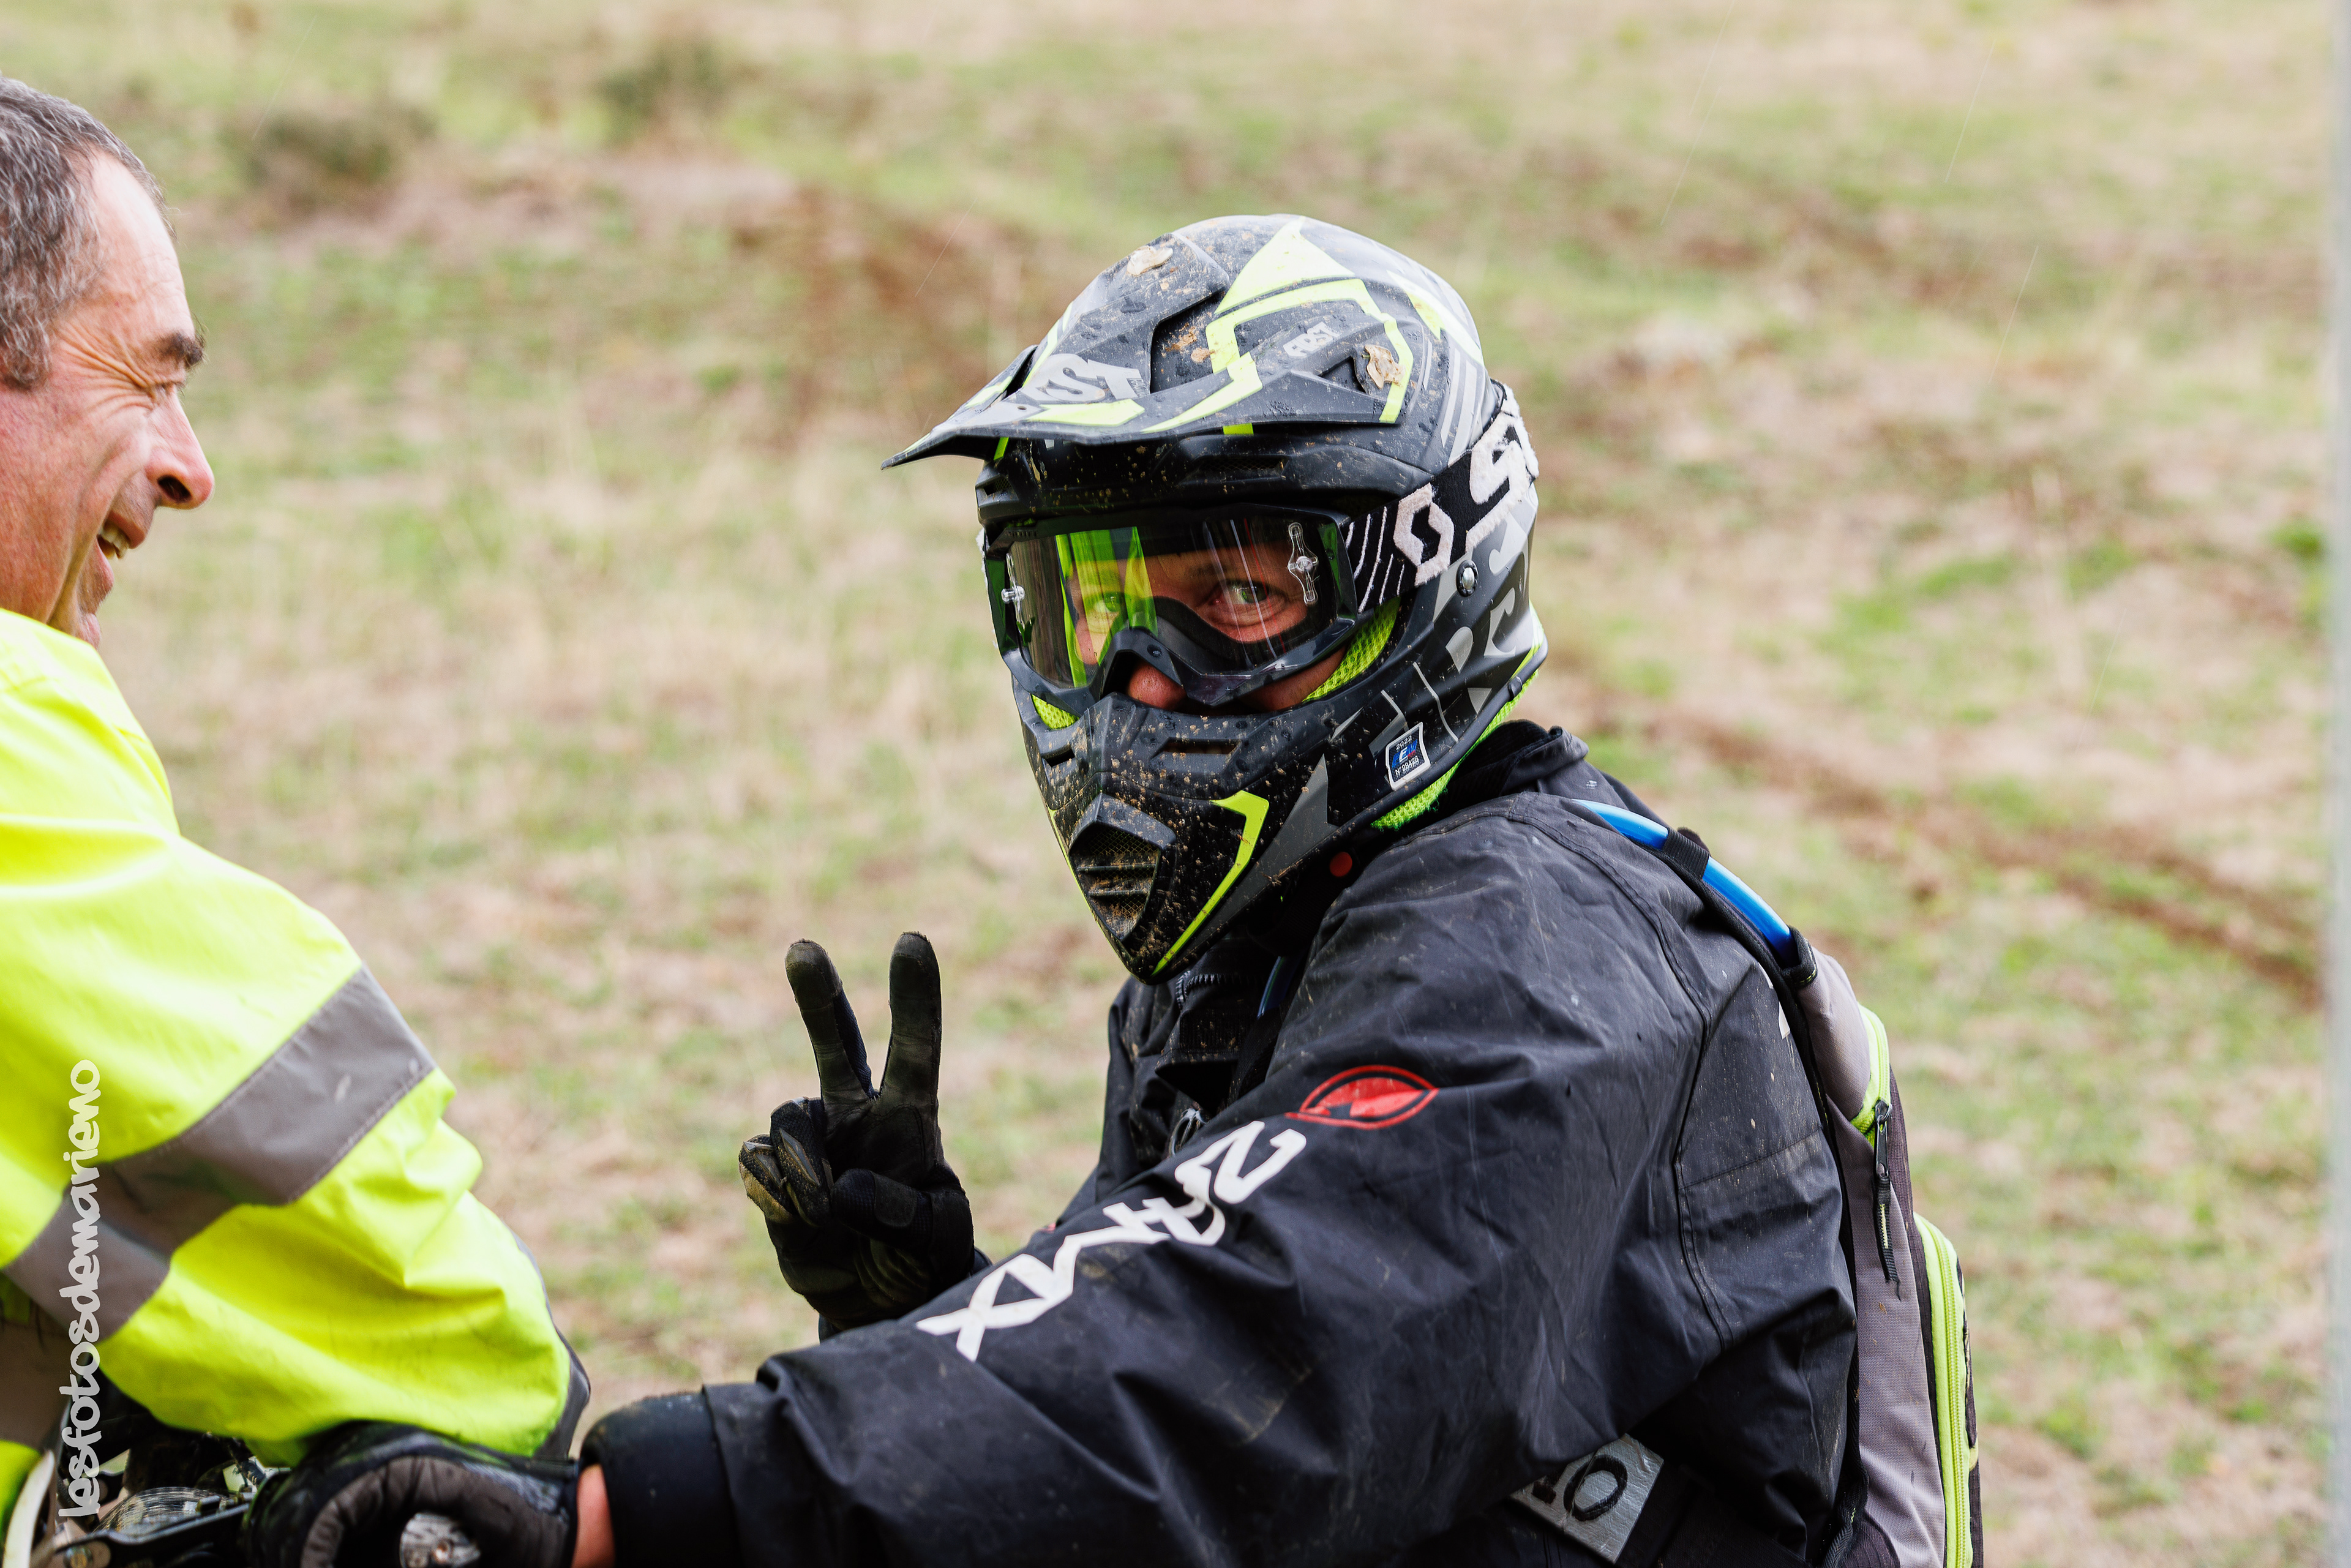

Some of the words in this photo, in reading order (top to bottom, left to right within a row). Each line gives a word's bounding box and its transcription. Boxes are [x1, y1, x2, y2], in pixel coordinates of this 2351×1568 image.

[1283, 321, 1340, 357] FIRST
[1396, 735, 1412, 751] 2022
[1401, 756, 1419, 772] 28428
